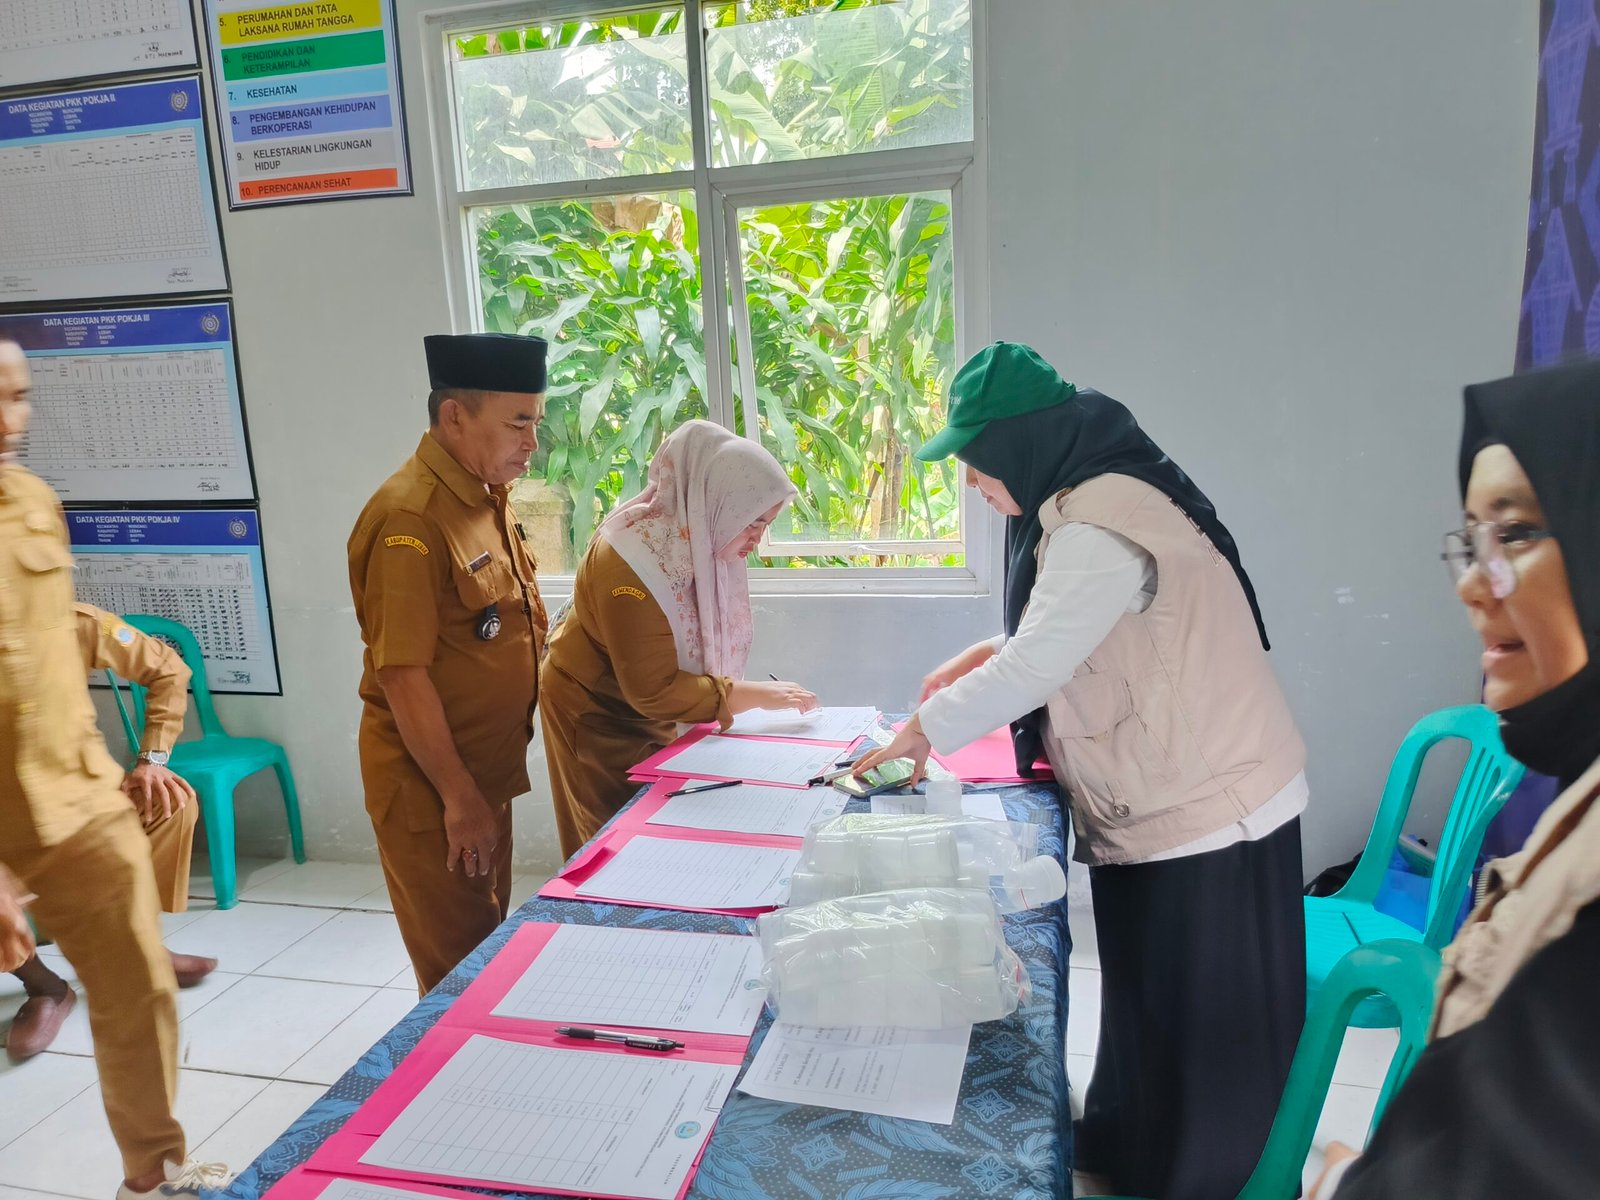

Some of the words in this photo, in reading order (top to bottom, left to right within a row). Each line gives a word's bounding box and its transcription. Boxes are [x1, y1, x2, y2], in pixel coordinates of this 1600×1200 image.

[219, 17, 227, 27] 5.
[238, 12, 292, 24] PERUMAHAN
[296, 7, 314, 18] DAN
[316, 4, 337, 14] TATA
[239, 23, 280, 36] LAKSANA
[282, 19, 314, 31] RUMAH
[316, 14, 354, 27] TANGGA
[223, 55, 231, 64] 6.
[242, 49, 294, 62] PENDIDIKAN
[296, 45, 315, 55] DAN
[244, 59, 310, 74] KETERAMPILAN
[229, 92, 236, 100] 7.
[247, 85, 297, 98] KESEHATAN
[8, 104, 27, 114] DATA
[28, 99, 65, 112] KEGIATAN
[65, 96, 82, 107] PKK
[84, 94, 110, 105] POKJA
[110, 93, 116, 102] II
[232, 116, 240, 125] 8.
[250, 109, 322, 123] PENGEMBANGAN
[324, 101, 376, 115] KEHIDUPAN
[251, 122, 312, 136] BERKOPERASI
[237, 152, 244, 161] 9.
[254, 146, 312, 158] KELESTARIAN
[314, 139, 372, 153] LINGKUNGAN
[255, 161, 281, 171] HIDUP
[241, 187, 253, 196] 10.
[258, 182, 321, 194] PERENCANAAN
[323, 178, 351, 188] SEHAT
[44, 318, 62, 326] DATA
[62, 316, 100, 325] KEGIATAN
[101, 316, 116, 324] PKK
[118, 314, 143, 323] POKJA
[76, 516, 94, 524] DATA
[95, 516, 130, 524] KEGIATAN
